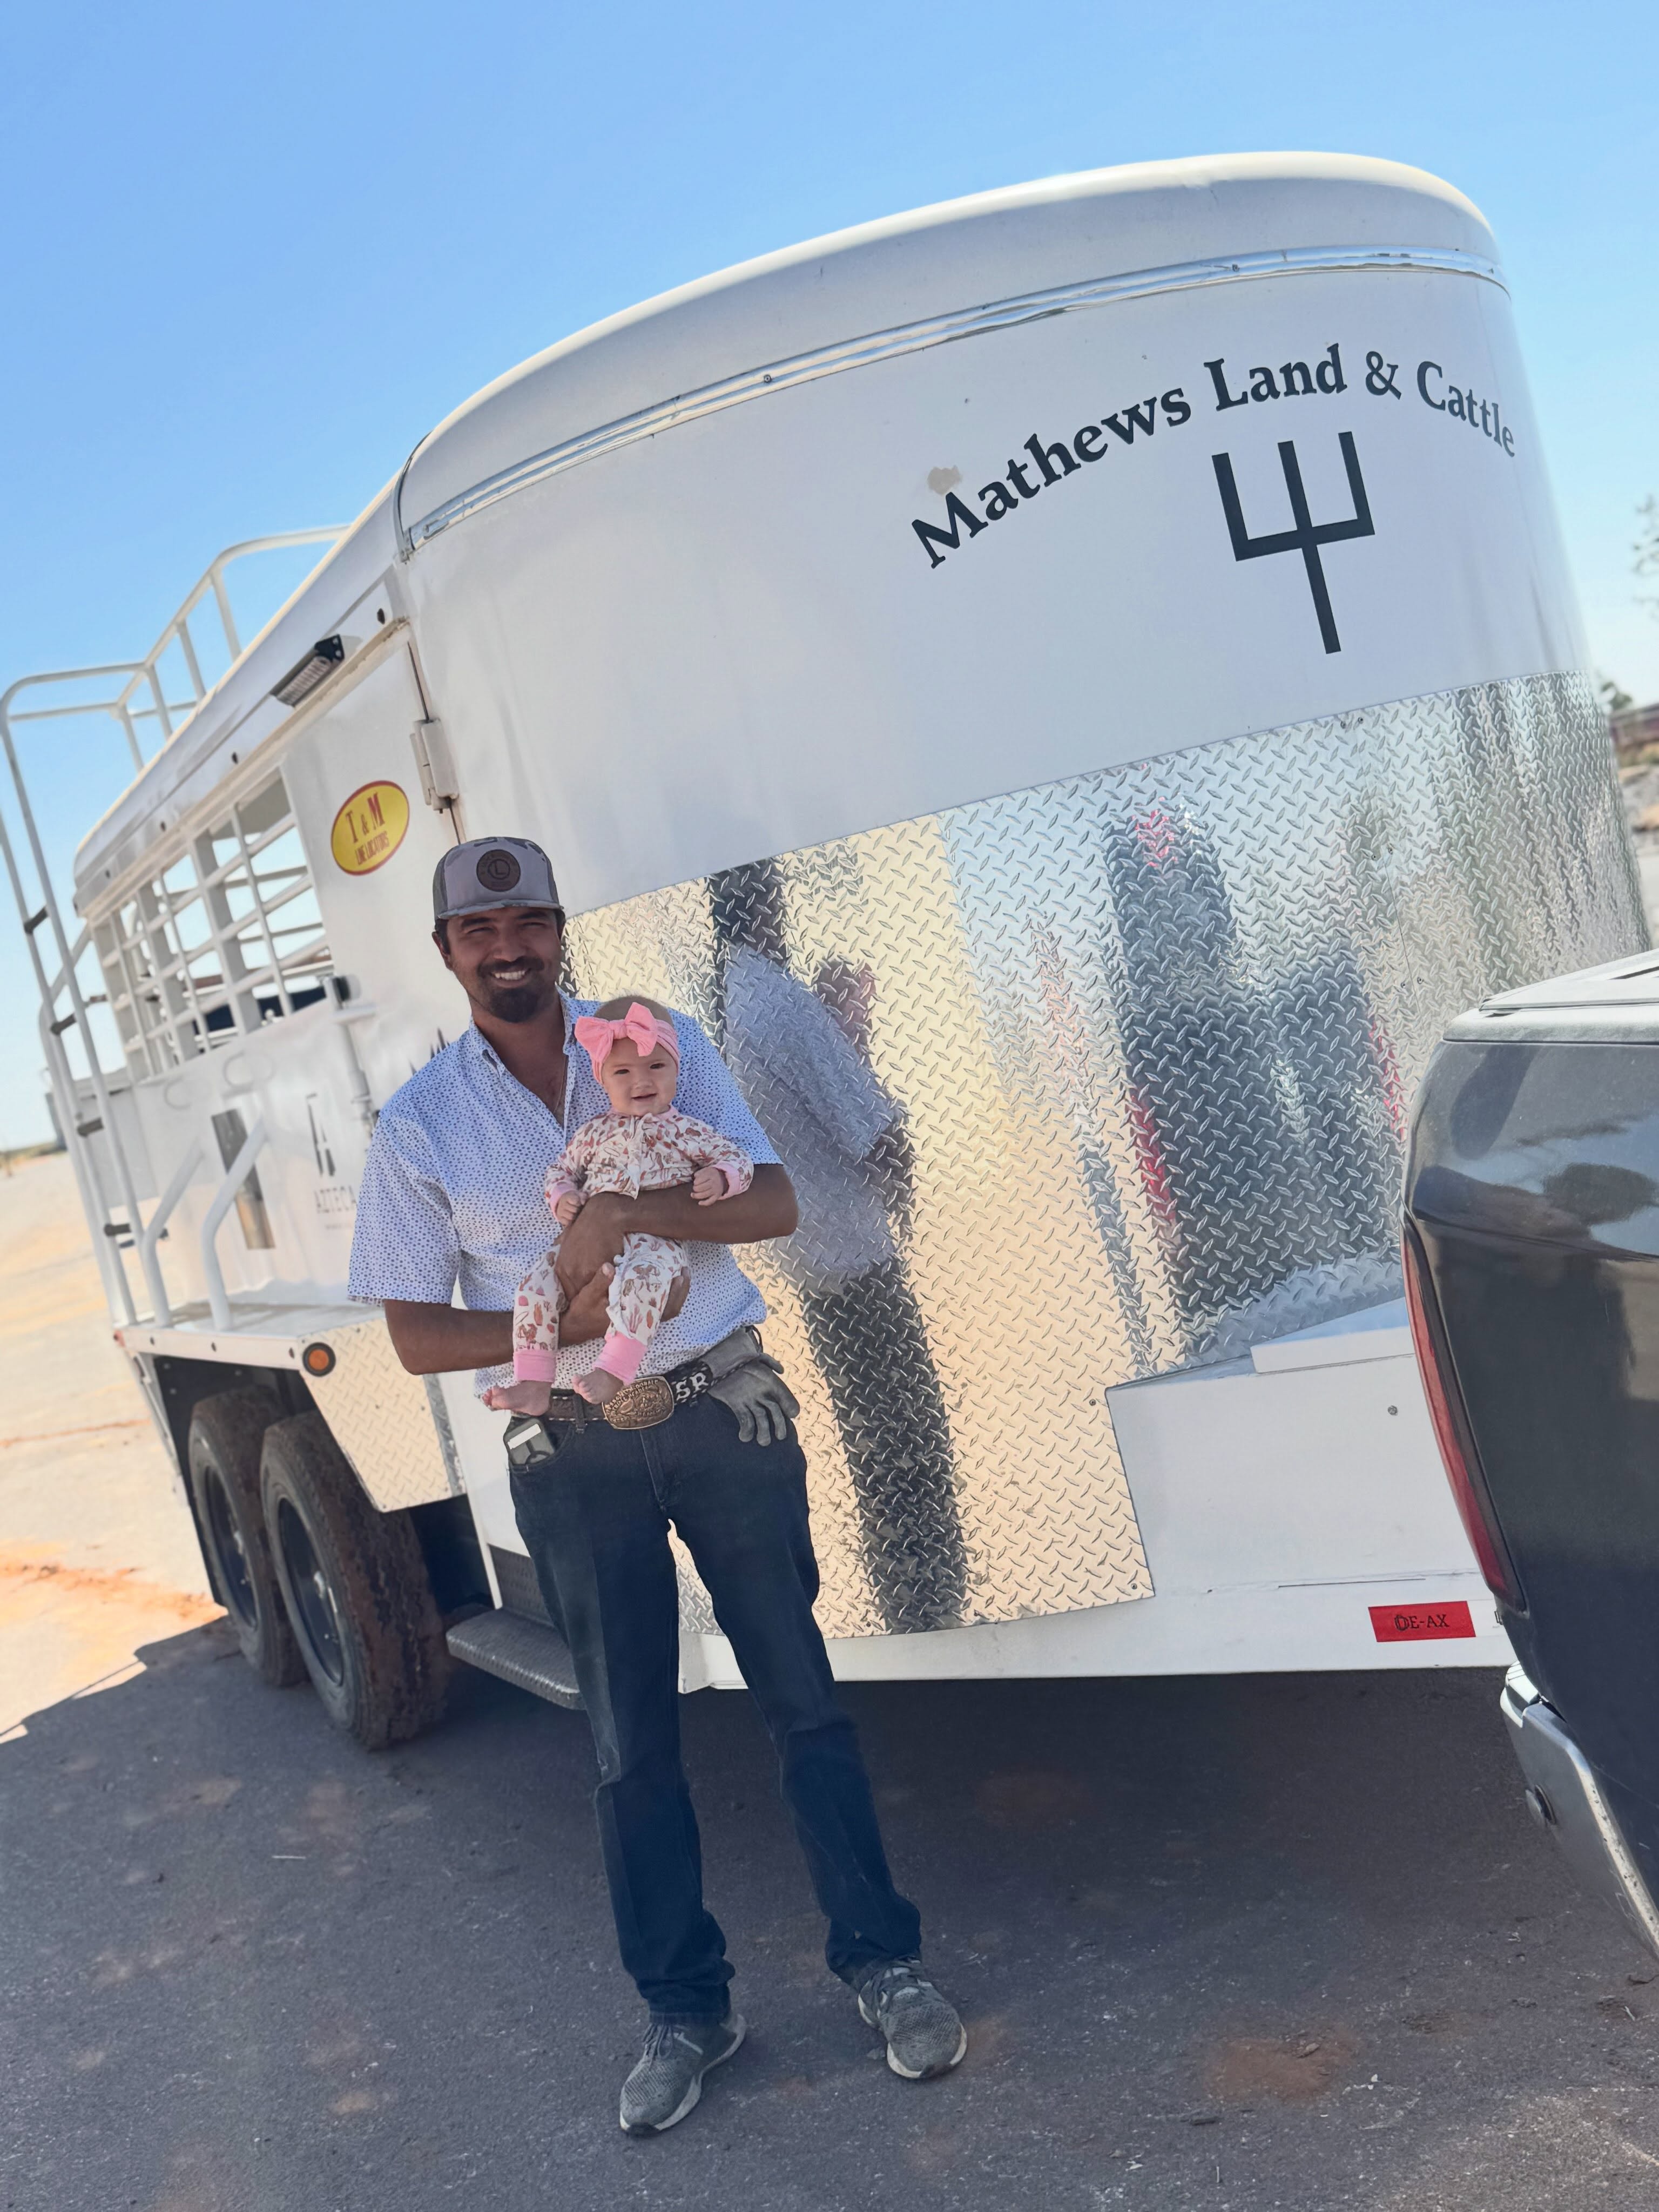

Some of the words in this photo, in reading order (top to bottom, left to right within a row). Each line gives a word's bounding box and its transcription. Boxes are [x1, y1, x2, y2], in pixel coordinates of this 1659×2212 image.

[911, 387, 1191, 569] Mathews
[1203, 342, 1348, 412] Land
[1365, 350, 1402, 400] &
[1417, 361, 1515, 458] Cattle
[345, 810, 359, 844] T
[367, 791, 386, 831] M
[675, 1372, 709, 1401] SR
